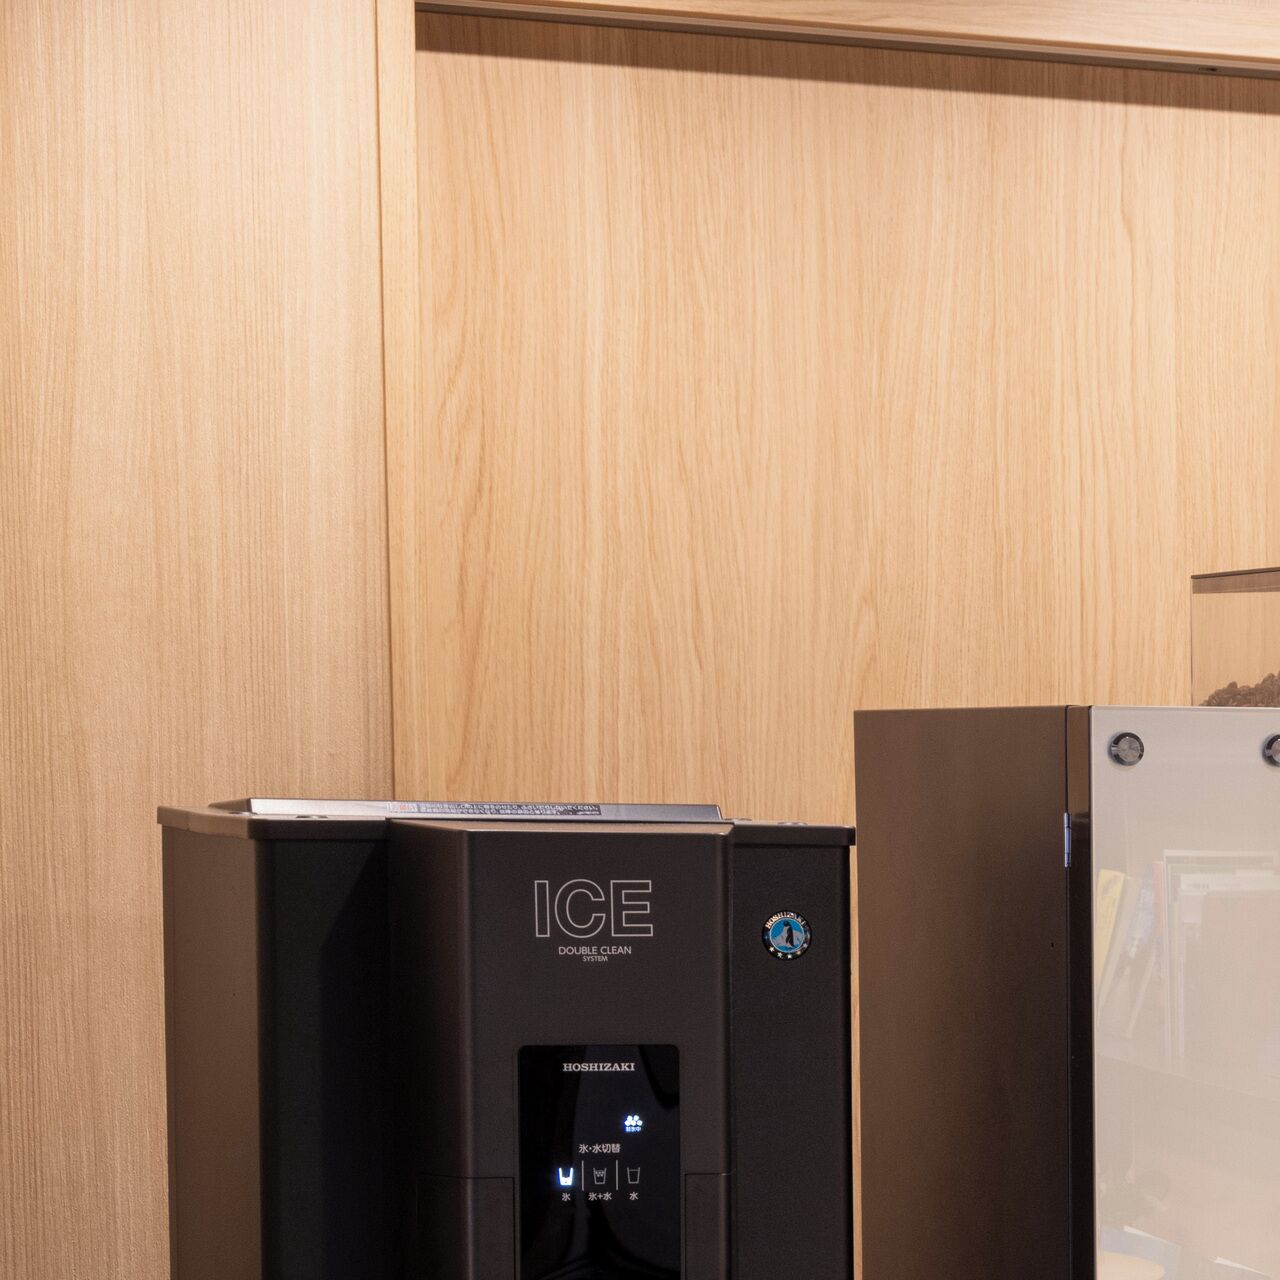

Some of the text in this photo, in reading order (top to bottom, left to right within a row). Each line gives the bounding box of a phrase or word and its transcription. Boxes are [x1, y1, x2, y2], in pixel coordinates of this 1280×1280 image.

[535, 879, 653, 938] ICE
[559, 945, 632, 955] DOUBLE CLEAN
[563, 1063, 635, 1072] HOSHIZAKI
[562, 1192, 571, 1202] 氷
[629, 1191, 639, 1201] 水
